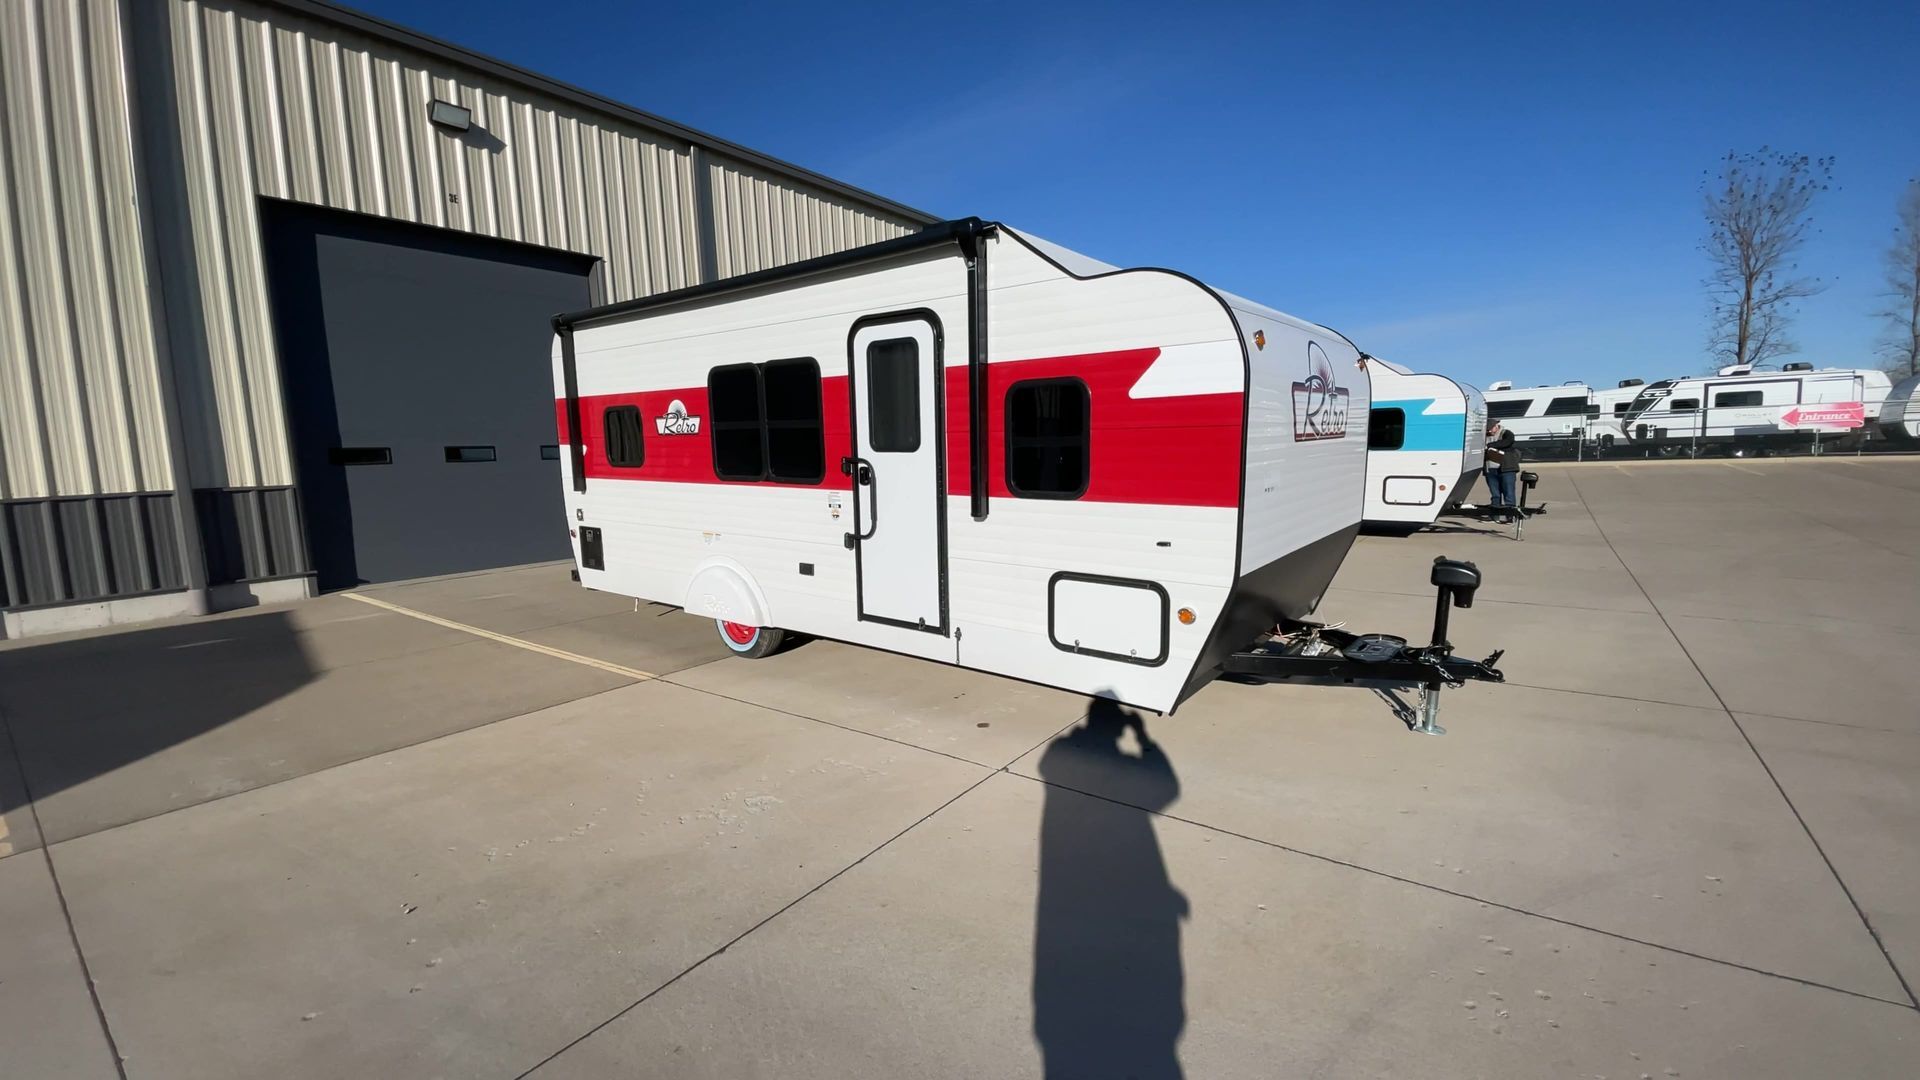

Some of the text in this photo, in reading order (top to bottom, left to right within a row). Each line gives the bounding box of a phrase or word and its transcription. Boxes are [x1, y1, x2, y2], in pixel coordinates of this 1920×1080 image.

[1302, 375, 1344, 439] Retro
[1798, 411, 1852, 421] Entrance
[663, 412, 696, 434] Retro
